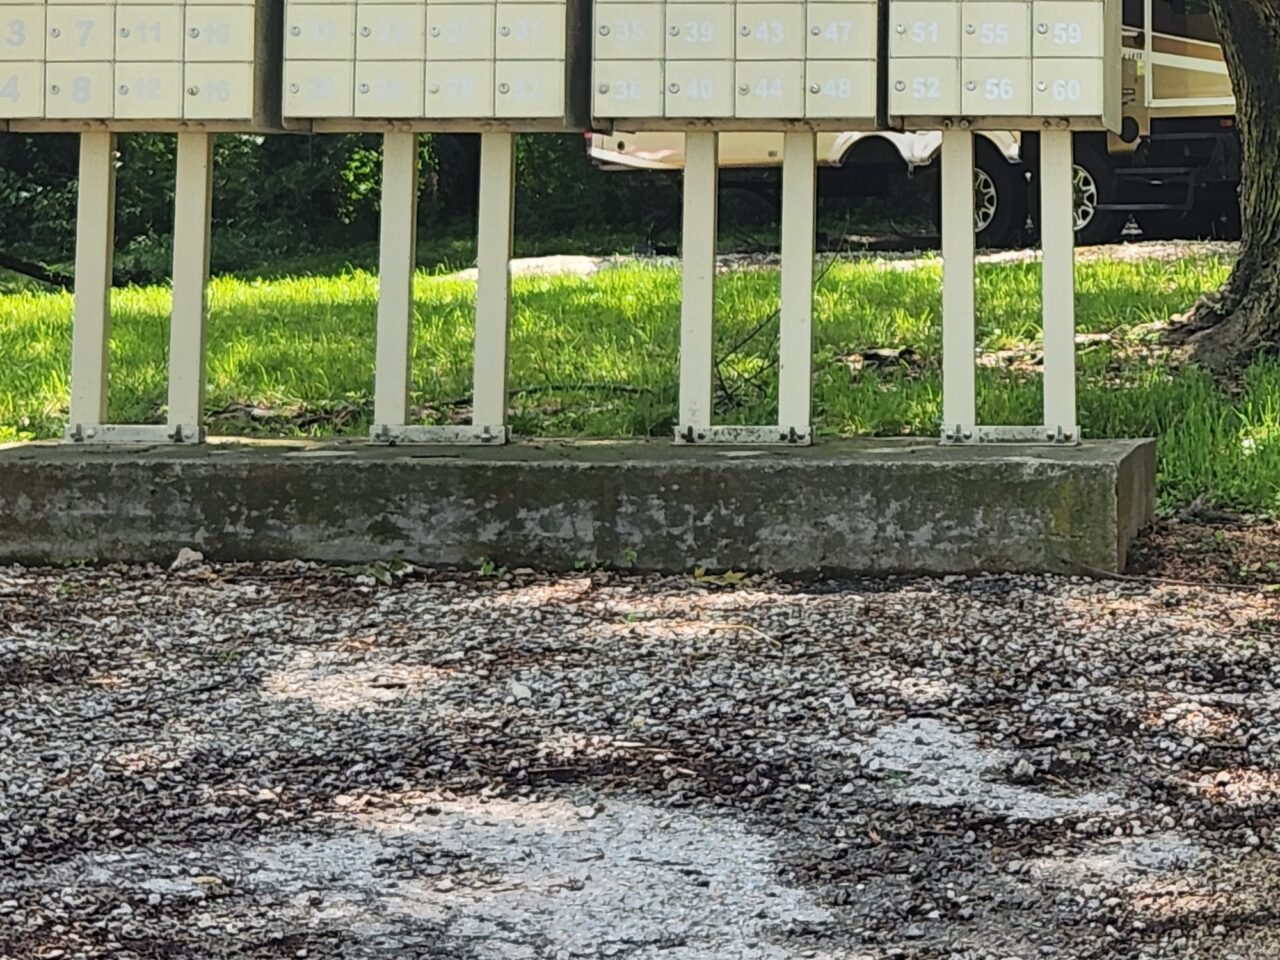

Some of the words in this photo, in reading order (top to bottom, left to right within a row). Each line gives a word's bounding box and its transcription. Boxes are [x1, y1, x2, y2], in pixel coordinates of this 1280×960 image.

[5, 19, 26, 47] 3
[75, 20, 95, 48] 7
[135, 21, 161, 43] 11
[685, 22, 714, 42] 39
[756, 22, 784, 42] 43
[823, 21, 853, 42] 47
[912, 22, 940, 42] 51
[981, 23, 1009, 44] 55
[1053, 23, 1082, 45] 59
[0, 75, 20, 102] 4
[71, 76, 91, 103] 8
[687, 79, 713, 99] 40
[754, 79, 783, 98] 44
[823, 79, 851, 98] 48
[912, 77, 940, 98] 52
[985, 78, 1014, 99] 56
[1052, 80, 1081, 100] 60
